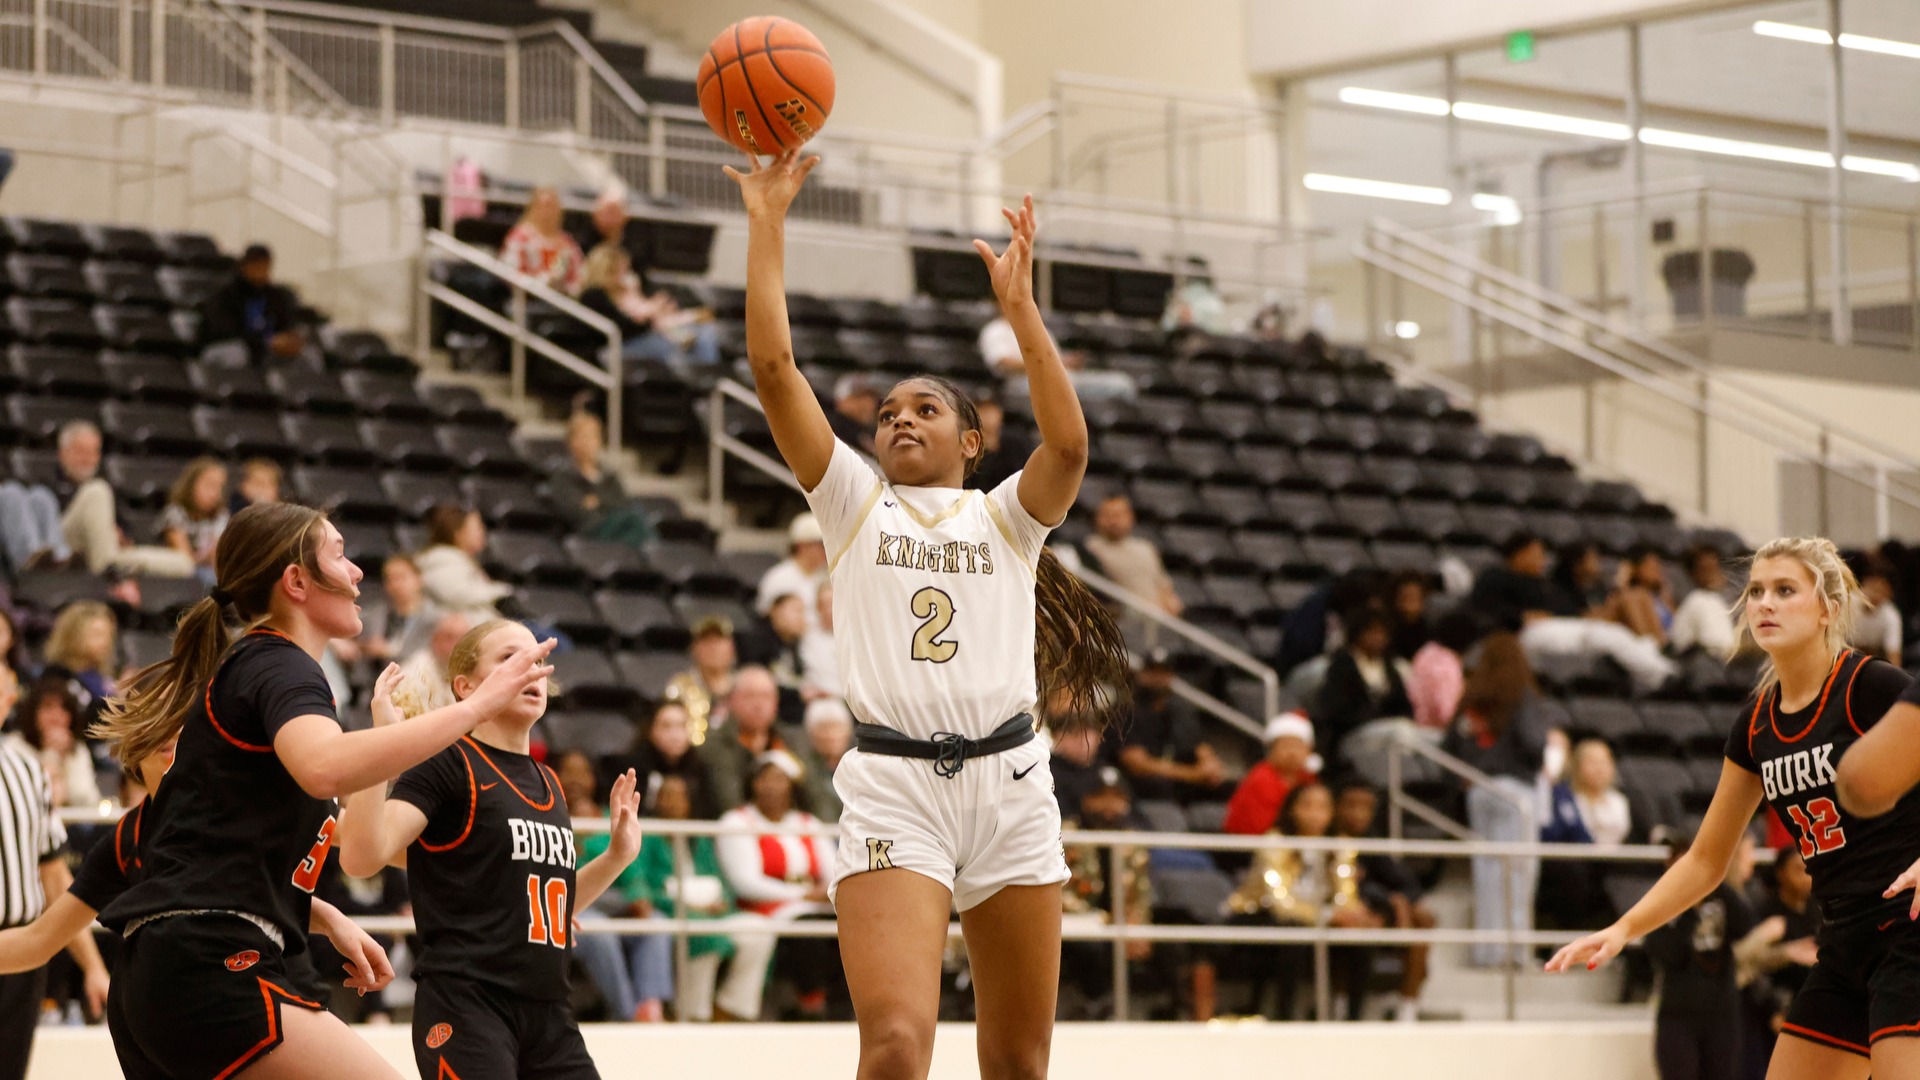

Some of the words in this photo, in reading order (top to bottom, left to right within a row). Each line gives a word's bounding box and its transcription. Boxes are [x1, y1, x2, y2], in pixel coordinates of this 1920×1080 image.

[876, 531, 994, 575] KNIGHTS
[911, 586, 958, 663] 2
[1761, 743, 1838, 801] BURK
[508, 818, 577, 871] BURK
[866, 837, 897, 872] K
[1787, 797, 1847, 860] 12
[527, 873, 567, 949] 10
